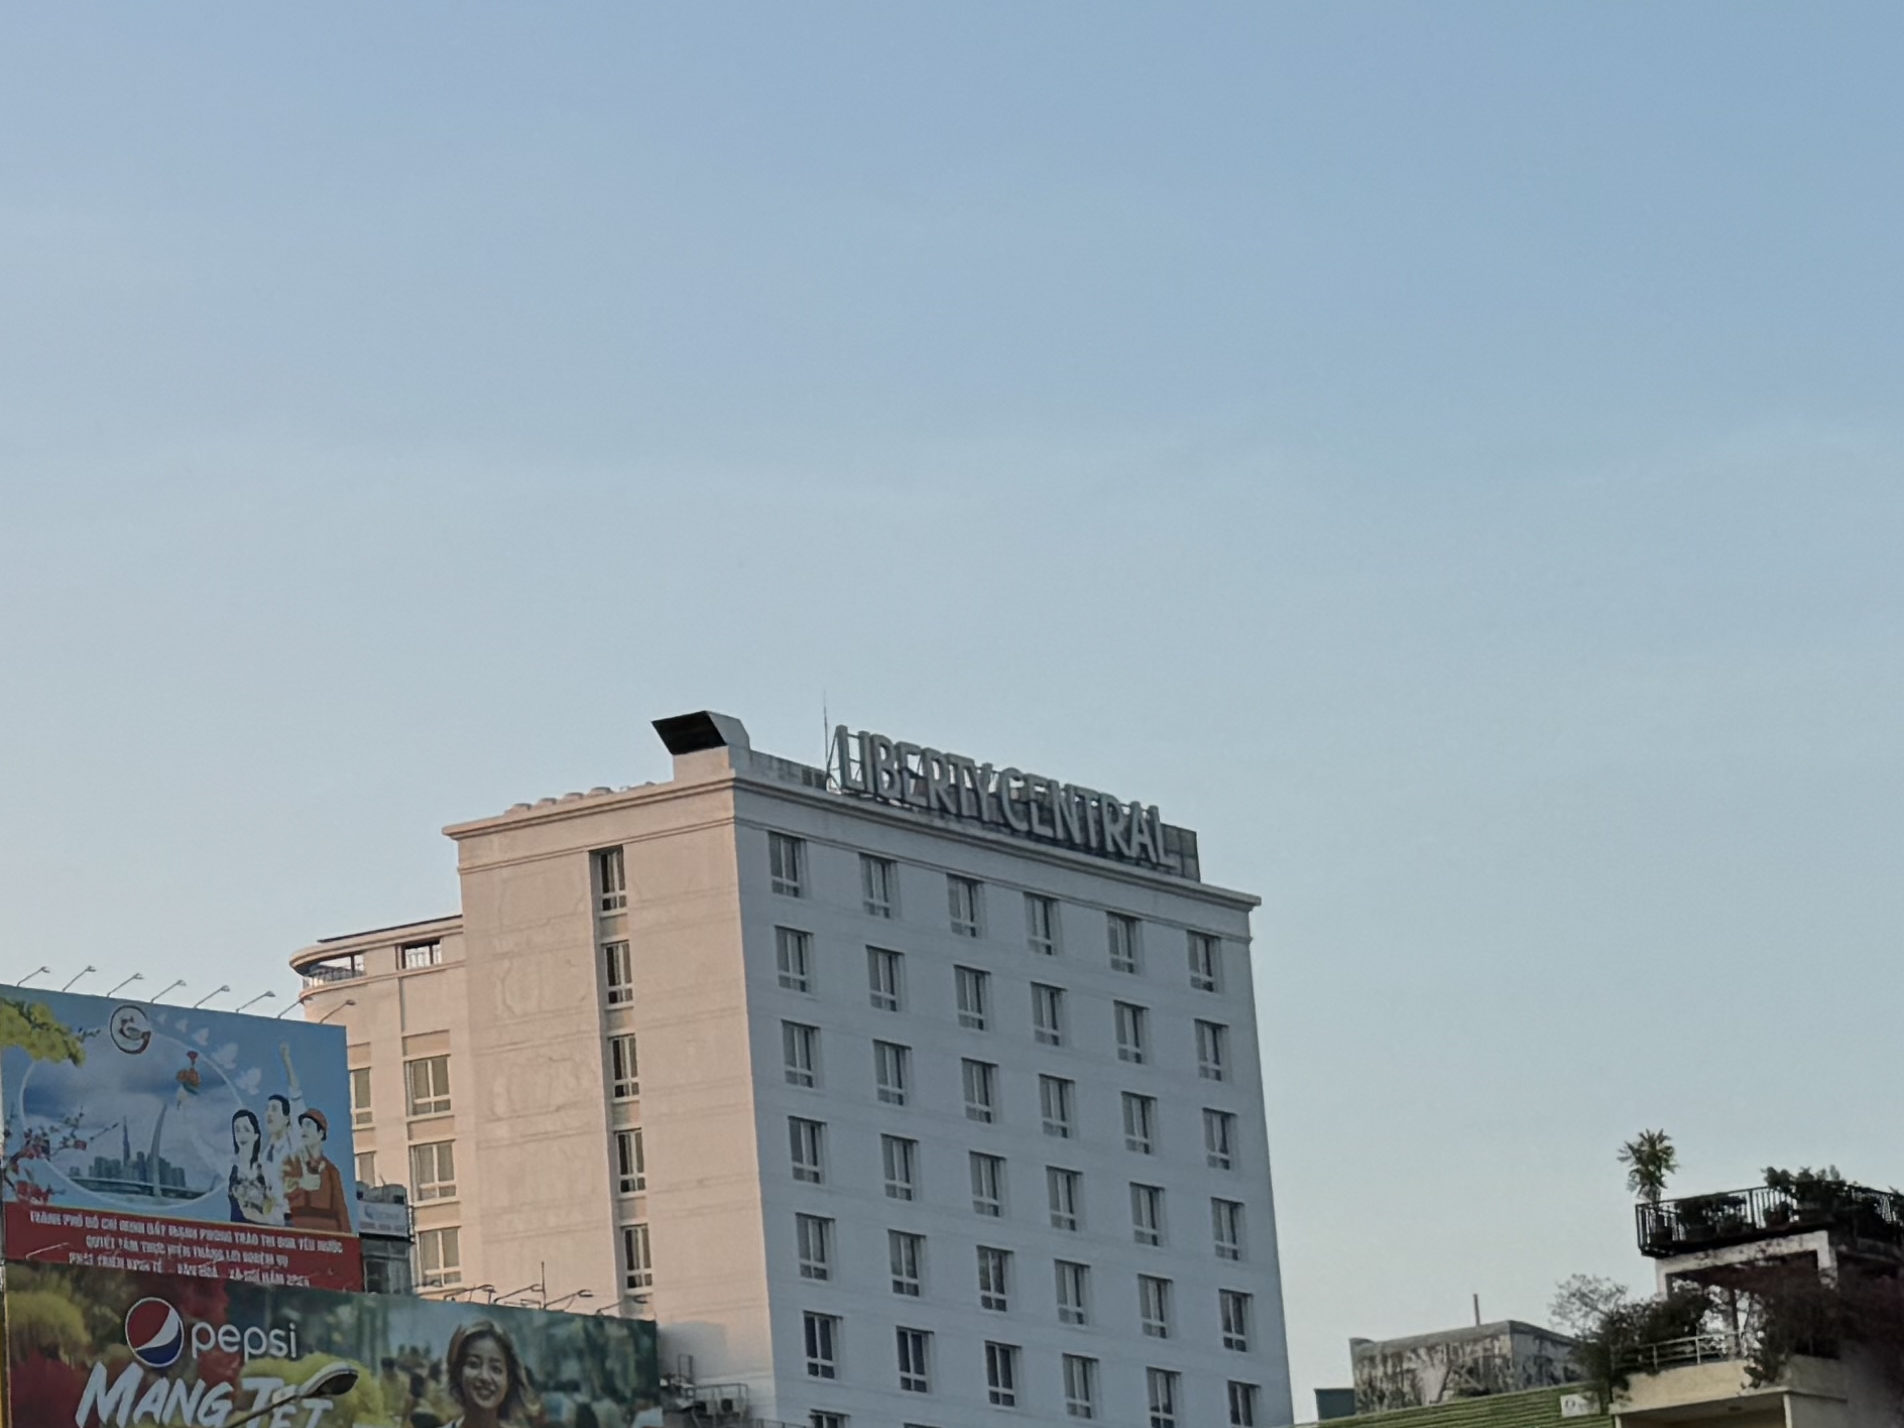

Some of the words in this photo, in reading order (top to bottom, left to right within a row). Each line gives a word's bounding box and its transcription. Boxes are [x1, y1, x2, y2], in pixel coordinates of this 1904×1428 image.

[837, 723, 993, 820] LIBERTY
[1001, 767, 1177, 869] CENTRAL
[192, 1322, 297, 1362] pepsi
